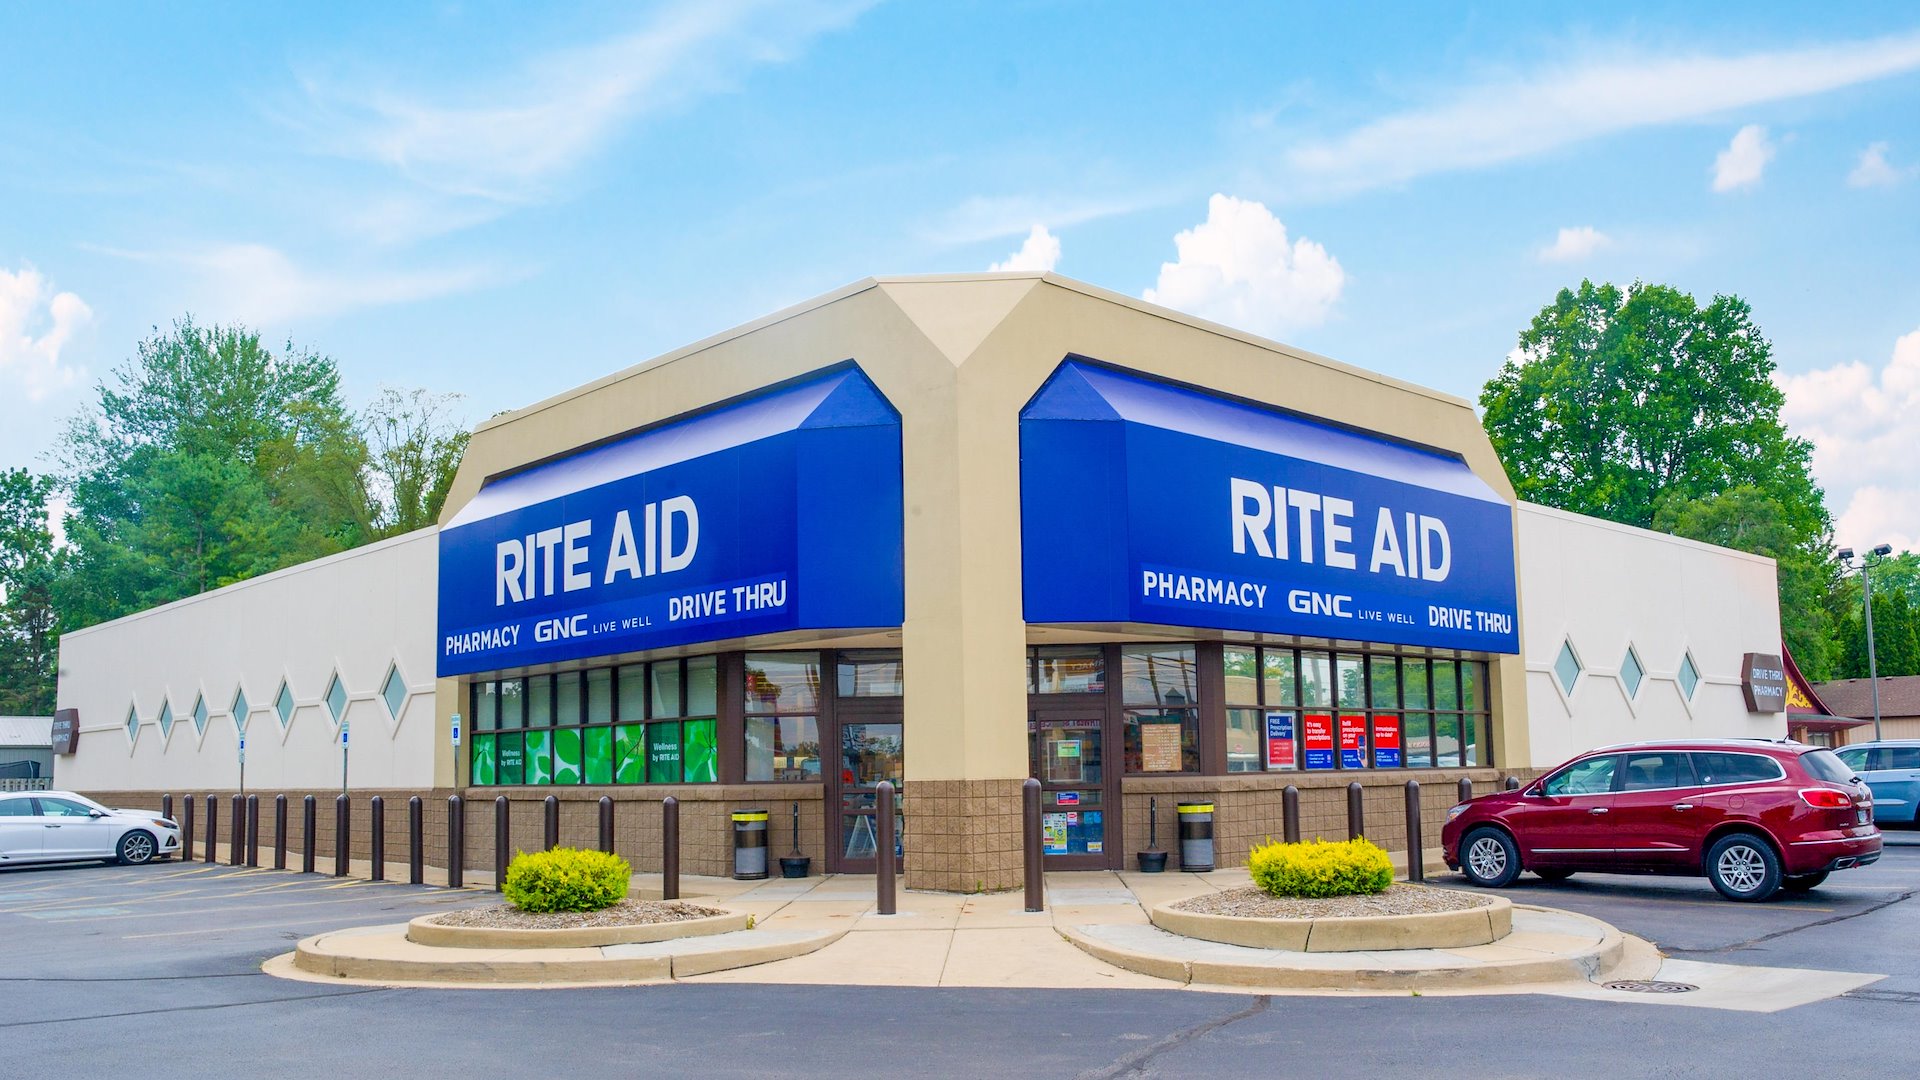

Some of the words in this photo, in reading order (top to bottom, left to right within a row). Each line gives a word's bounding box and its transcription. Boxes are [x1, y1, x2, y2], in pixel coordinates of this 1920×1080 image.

[1230, 476, 1356, 570] RITE
[1369, 506, 1452, 583] AID
[496, 519, 592, 606] RITE
[603, 495, 699, 585] AID
[669, 589, 726, 622] DRIVE
[732, 579, 787, 612] THRU
[1143, 570, 1267, 609] PHARMACY
[1288, 589, 1353, 618] GNC
[1358, 609, 1382, 621] LIVE
[1387, 612, 1415, 625] WELL
[1428, 605, 1473, 630] DRIVE
[1475, 611, 1512, 634] THRU
[445, 624, 520, 656] PHARMACY
[534, 613, 588, 643] GNC
[593, 621, 616, 634] LIVE
[621, 616, 652, 629] WELL
[1752, 668, 1768, 679] DRIVE
[1769, 669, 1783, 680] THRU
[1753, 684, 1783, 696] PHARMACY
[501, 749, 521, 757] Wellness
[652, 742, 678, 751] Wellness
[652, 754, 659, 762] by
[659, 753, 670, 761] RITE
[670, 753, 680, 761] AID
[500, 759, 506, 767] by
